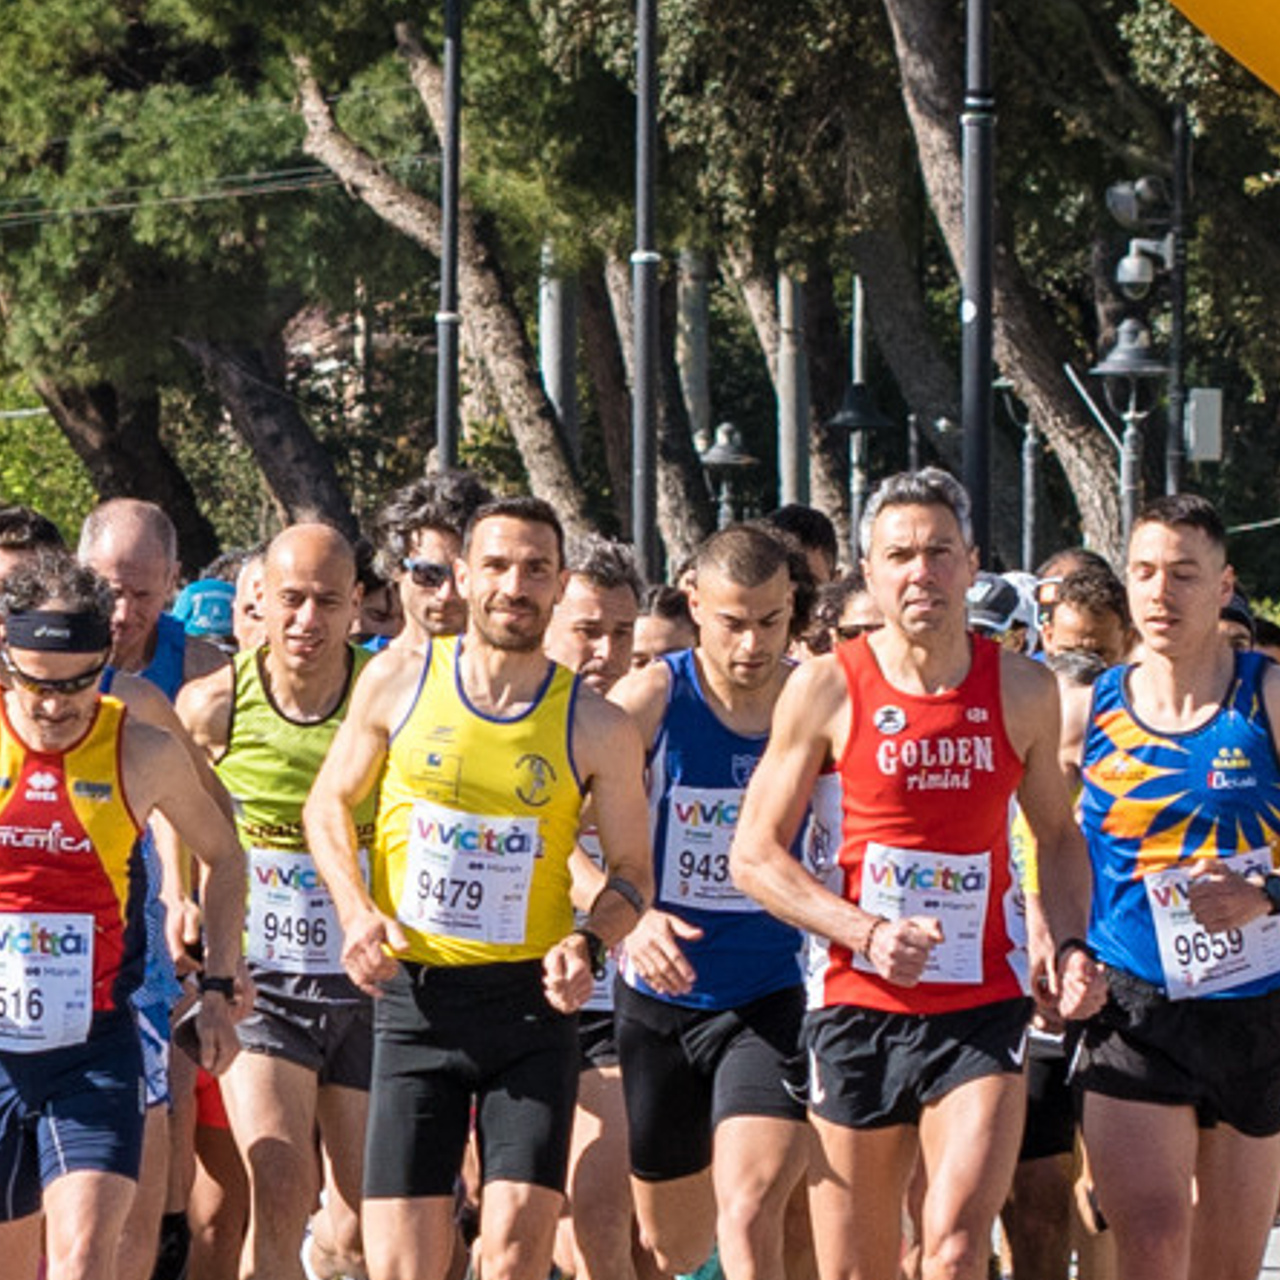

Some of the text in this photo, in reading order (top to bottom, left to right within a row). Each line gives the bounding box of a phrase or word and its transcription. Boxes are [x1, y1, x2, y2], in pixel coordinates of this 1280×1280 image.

[876, 736, 995, 776] GOLDEN
[907, 769, 971, 790] rimini
[417, 817, 527, 856] vivicittà
[679, 849, 730, 883] 943
[869, 860, 984, 894] vivicittà
[417, 869, 483, 911] 9479
[264, 912, 327, 947] 9496
[1174, 927, 1243, 966] 9659
